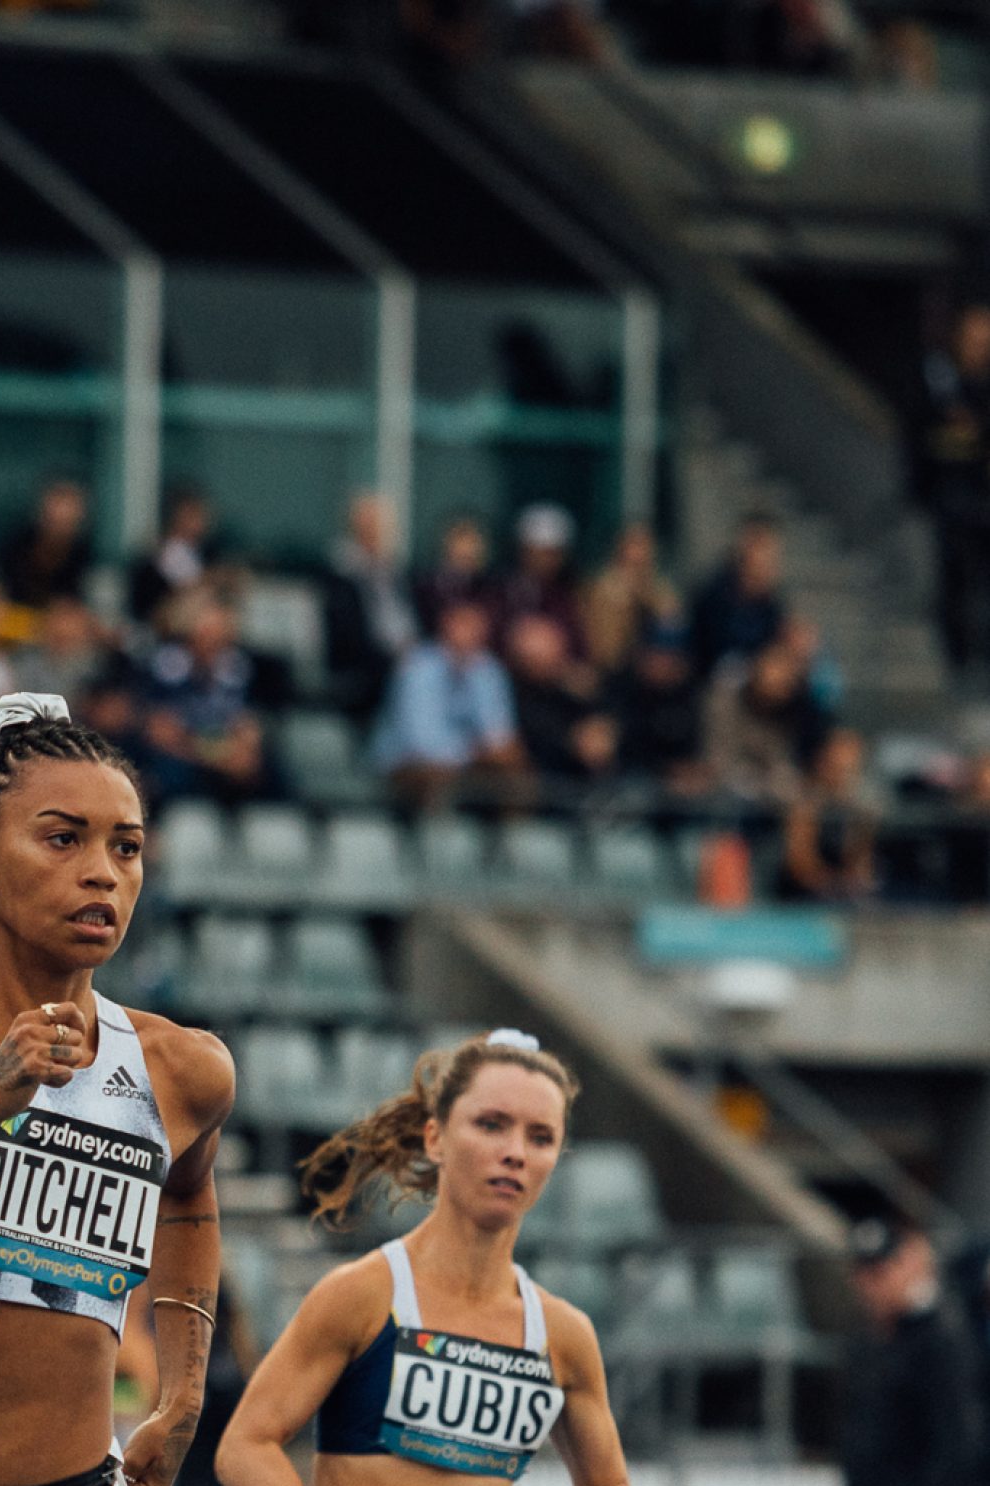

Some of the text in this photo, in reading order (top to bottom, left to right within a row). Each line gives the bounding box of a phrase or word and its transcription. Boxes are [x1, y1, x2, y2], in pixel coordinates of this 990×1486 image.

[102, 1086, 147, 1102] adidas
[28, 1119, 152, 1170] sydney.com
[31, 1235, 53, 1248] TRACK
[446, 1341, 551, 1380] sydney.com
[400, 1363, 551, 1446] CUBIS
